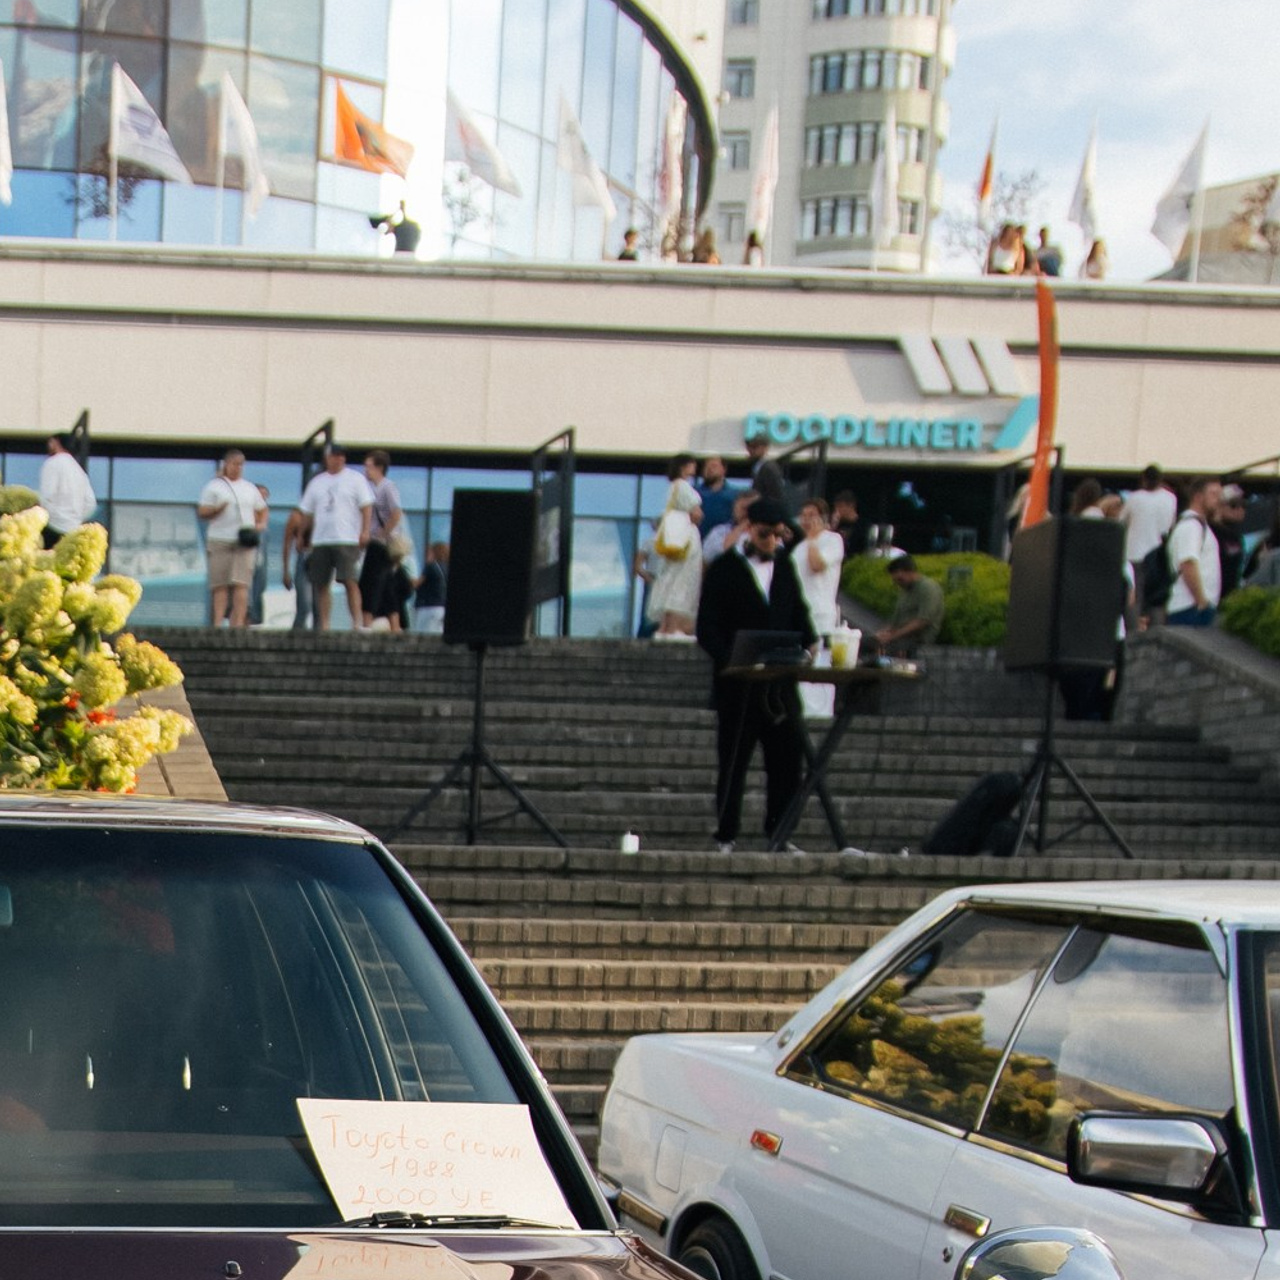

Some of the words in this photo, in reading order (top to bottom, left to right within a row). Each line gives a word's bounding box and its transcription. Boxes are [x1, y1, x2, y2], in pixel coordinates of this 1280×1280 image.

[743, 412, 981, 448] FOODLINER
[321, 1113, 430, 1159] Toyota
[379, 1156, 456, 1178] 1988
[352, 1185, 437, 1206] 2000
